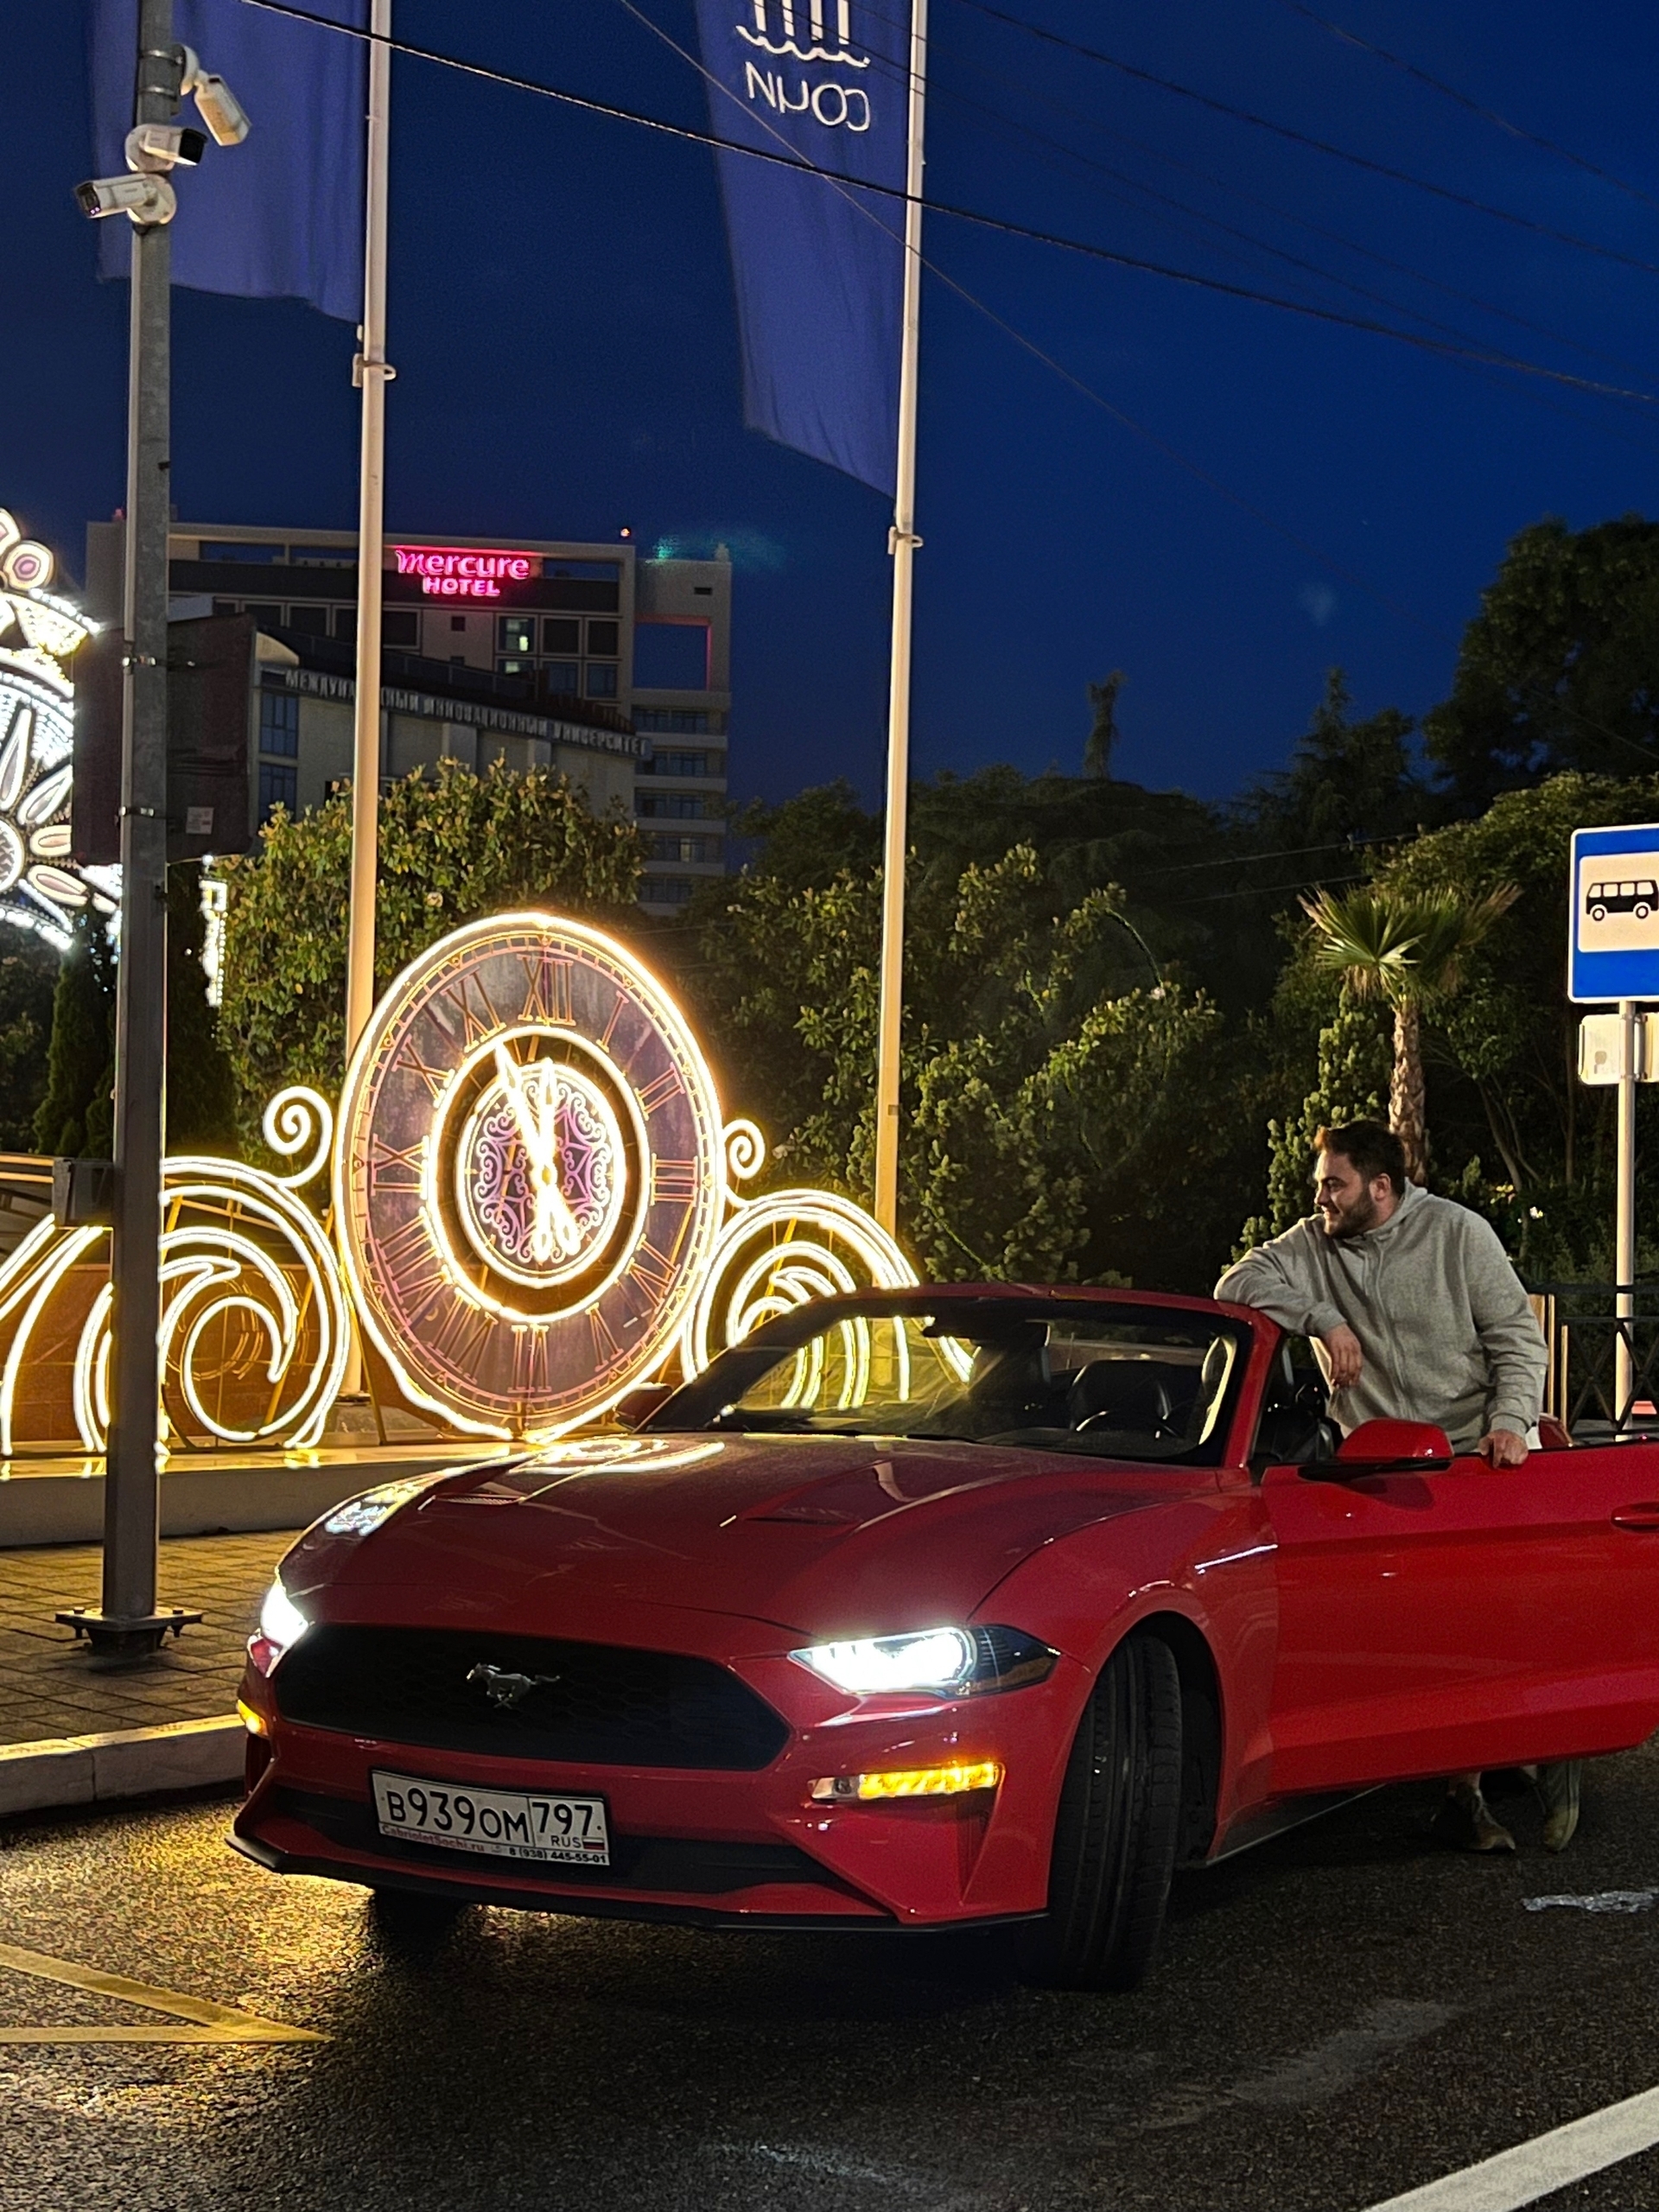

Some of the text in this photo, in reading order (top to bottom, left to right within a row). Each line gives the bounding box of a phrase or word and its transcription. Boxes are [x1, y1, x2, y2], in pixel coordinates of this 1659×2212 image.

[422, 576, 500, 597] HOTEL
[531, 1802, 593, 1836] 797
[381, 1825, 485, 1852] CabrioletSochi.ru
[509, 1847, 516, 1856] 8
[518, 1847, 548, 1860] (938)
[550, 1834, 582, 1848] RUS
